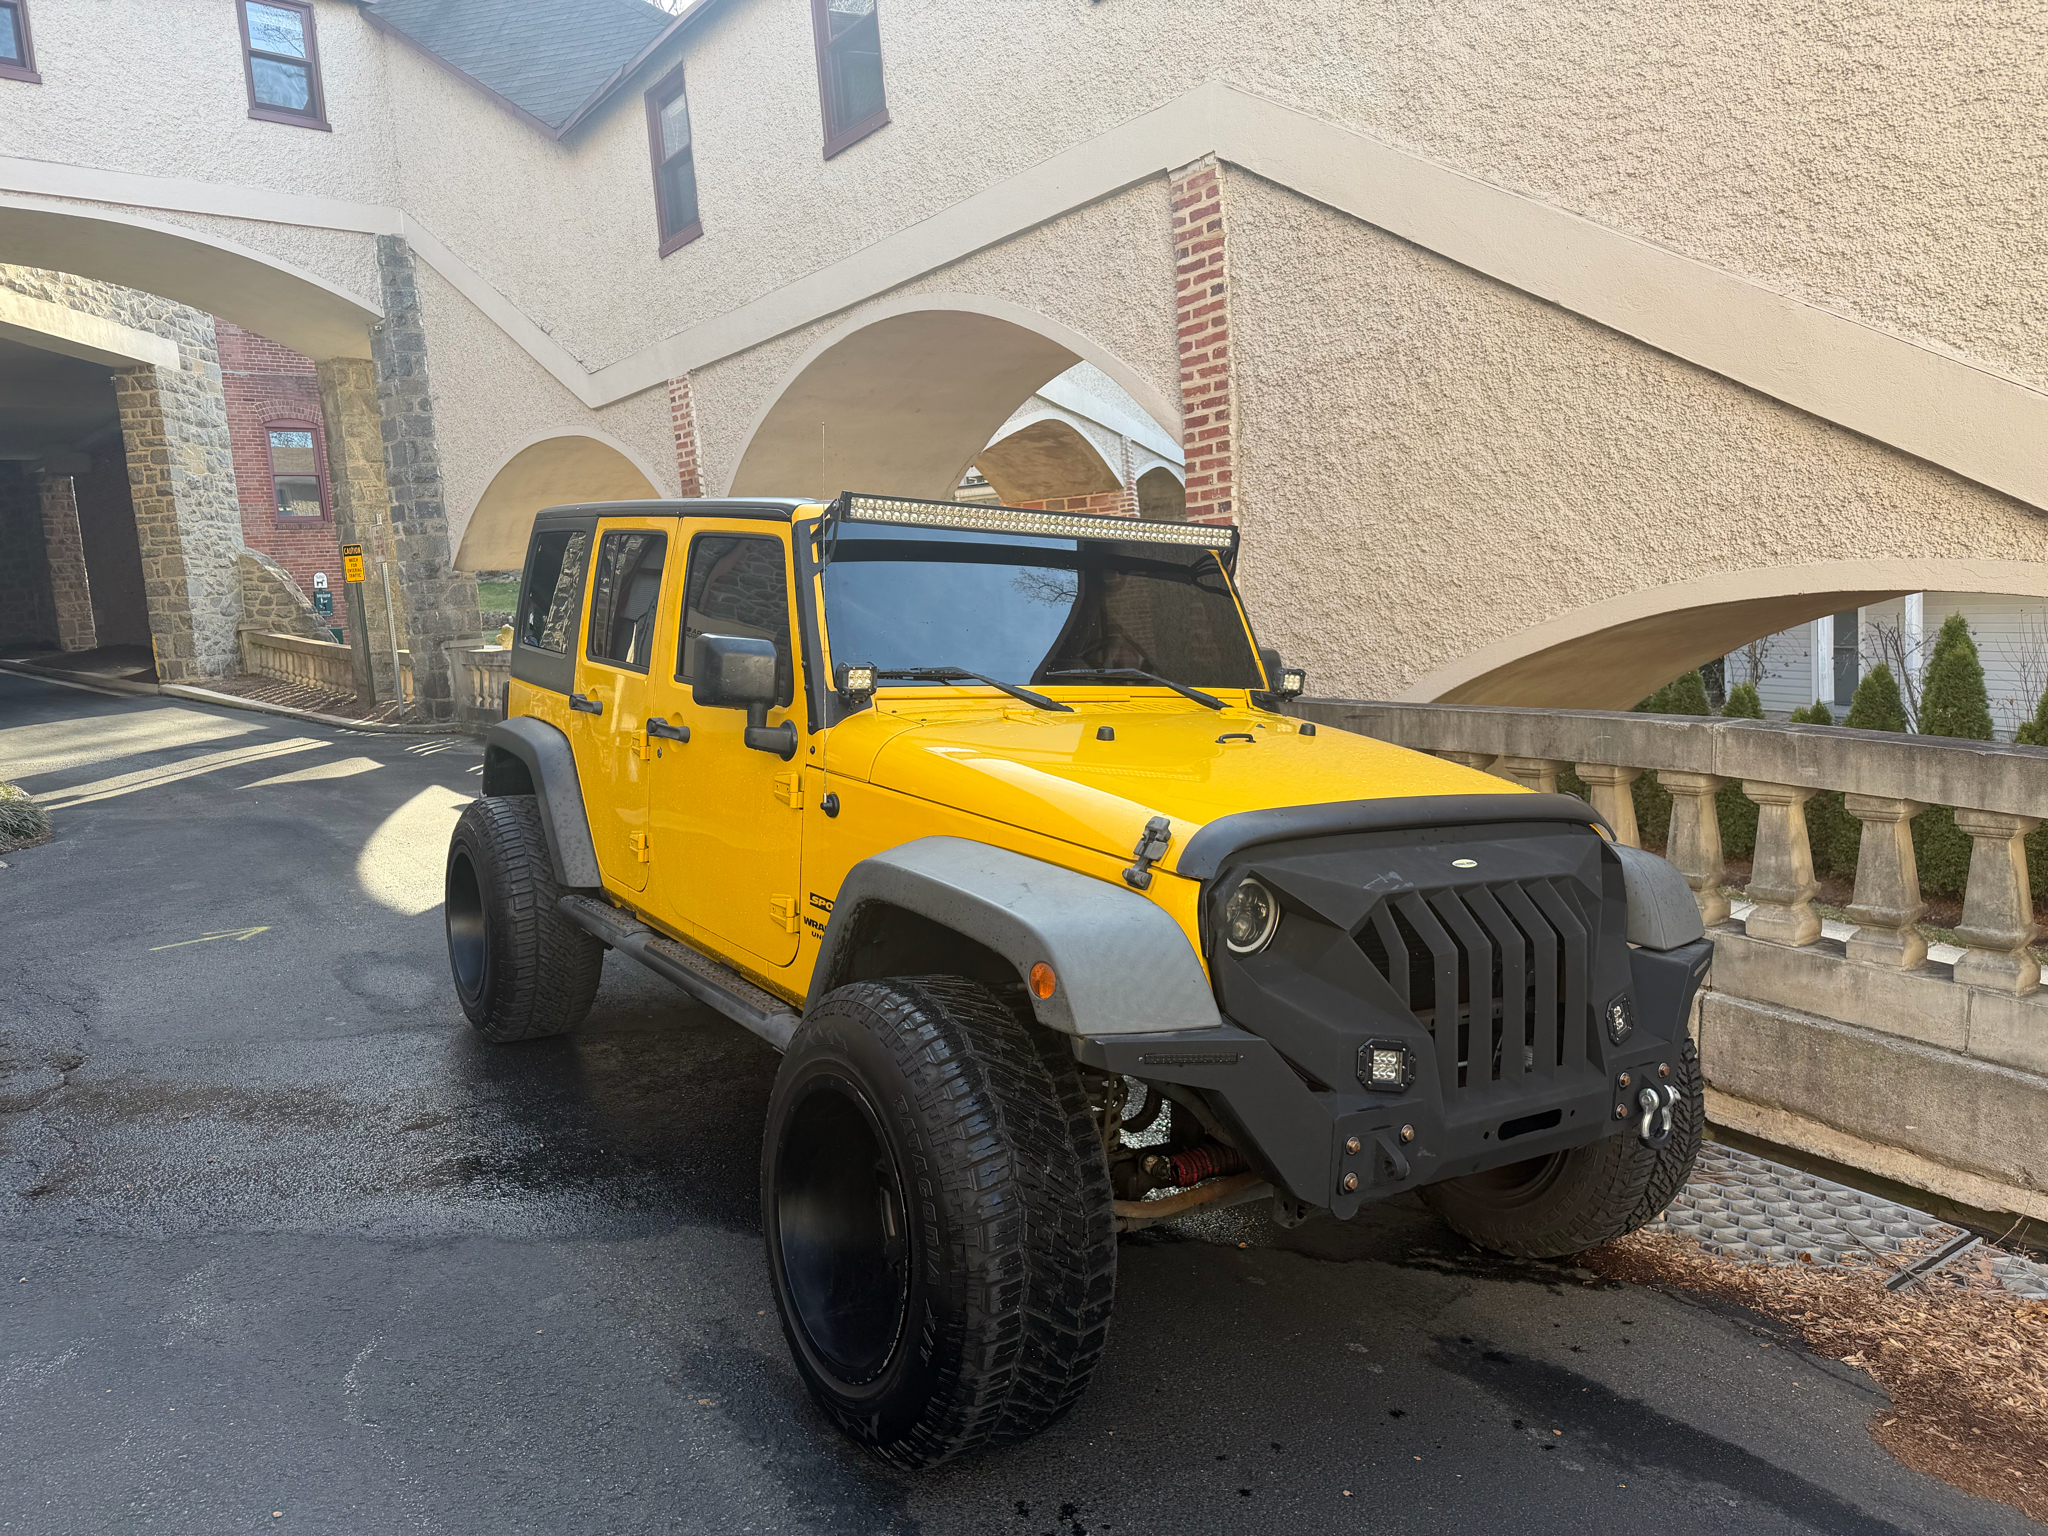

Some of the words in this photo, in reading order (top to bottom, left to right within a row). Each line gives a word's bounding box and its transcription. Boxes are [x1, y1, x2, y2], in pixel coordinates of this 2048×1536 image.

[804, 916, 827, 932] WRA
[812, 931, 824, 940] UN
[893, 1092, 941, 1286] PATAGONIA
